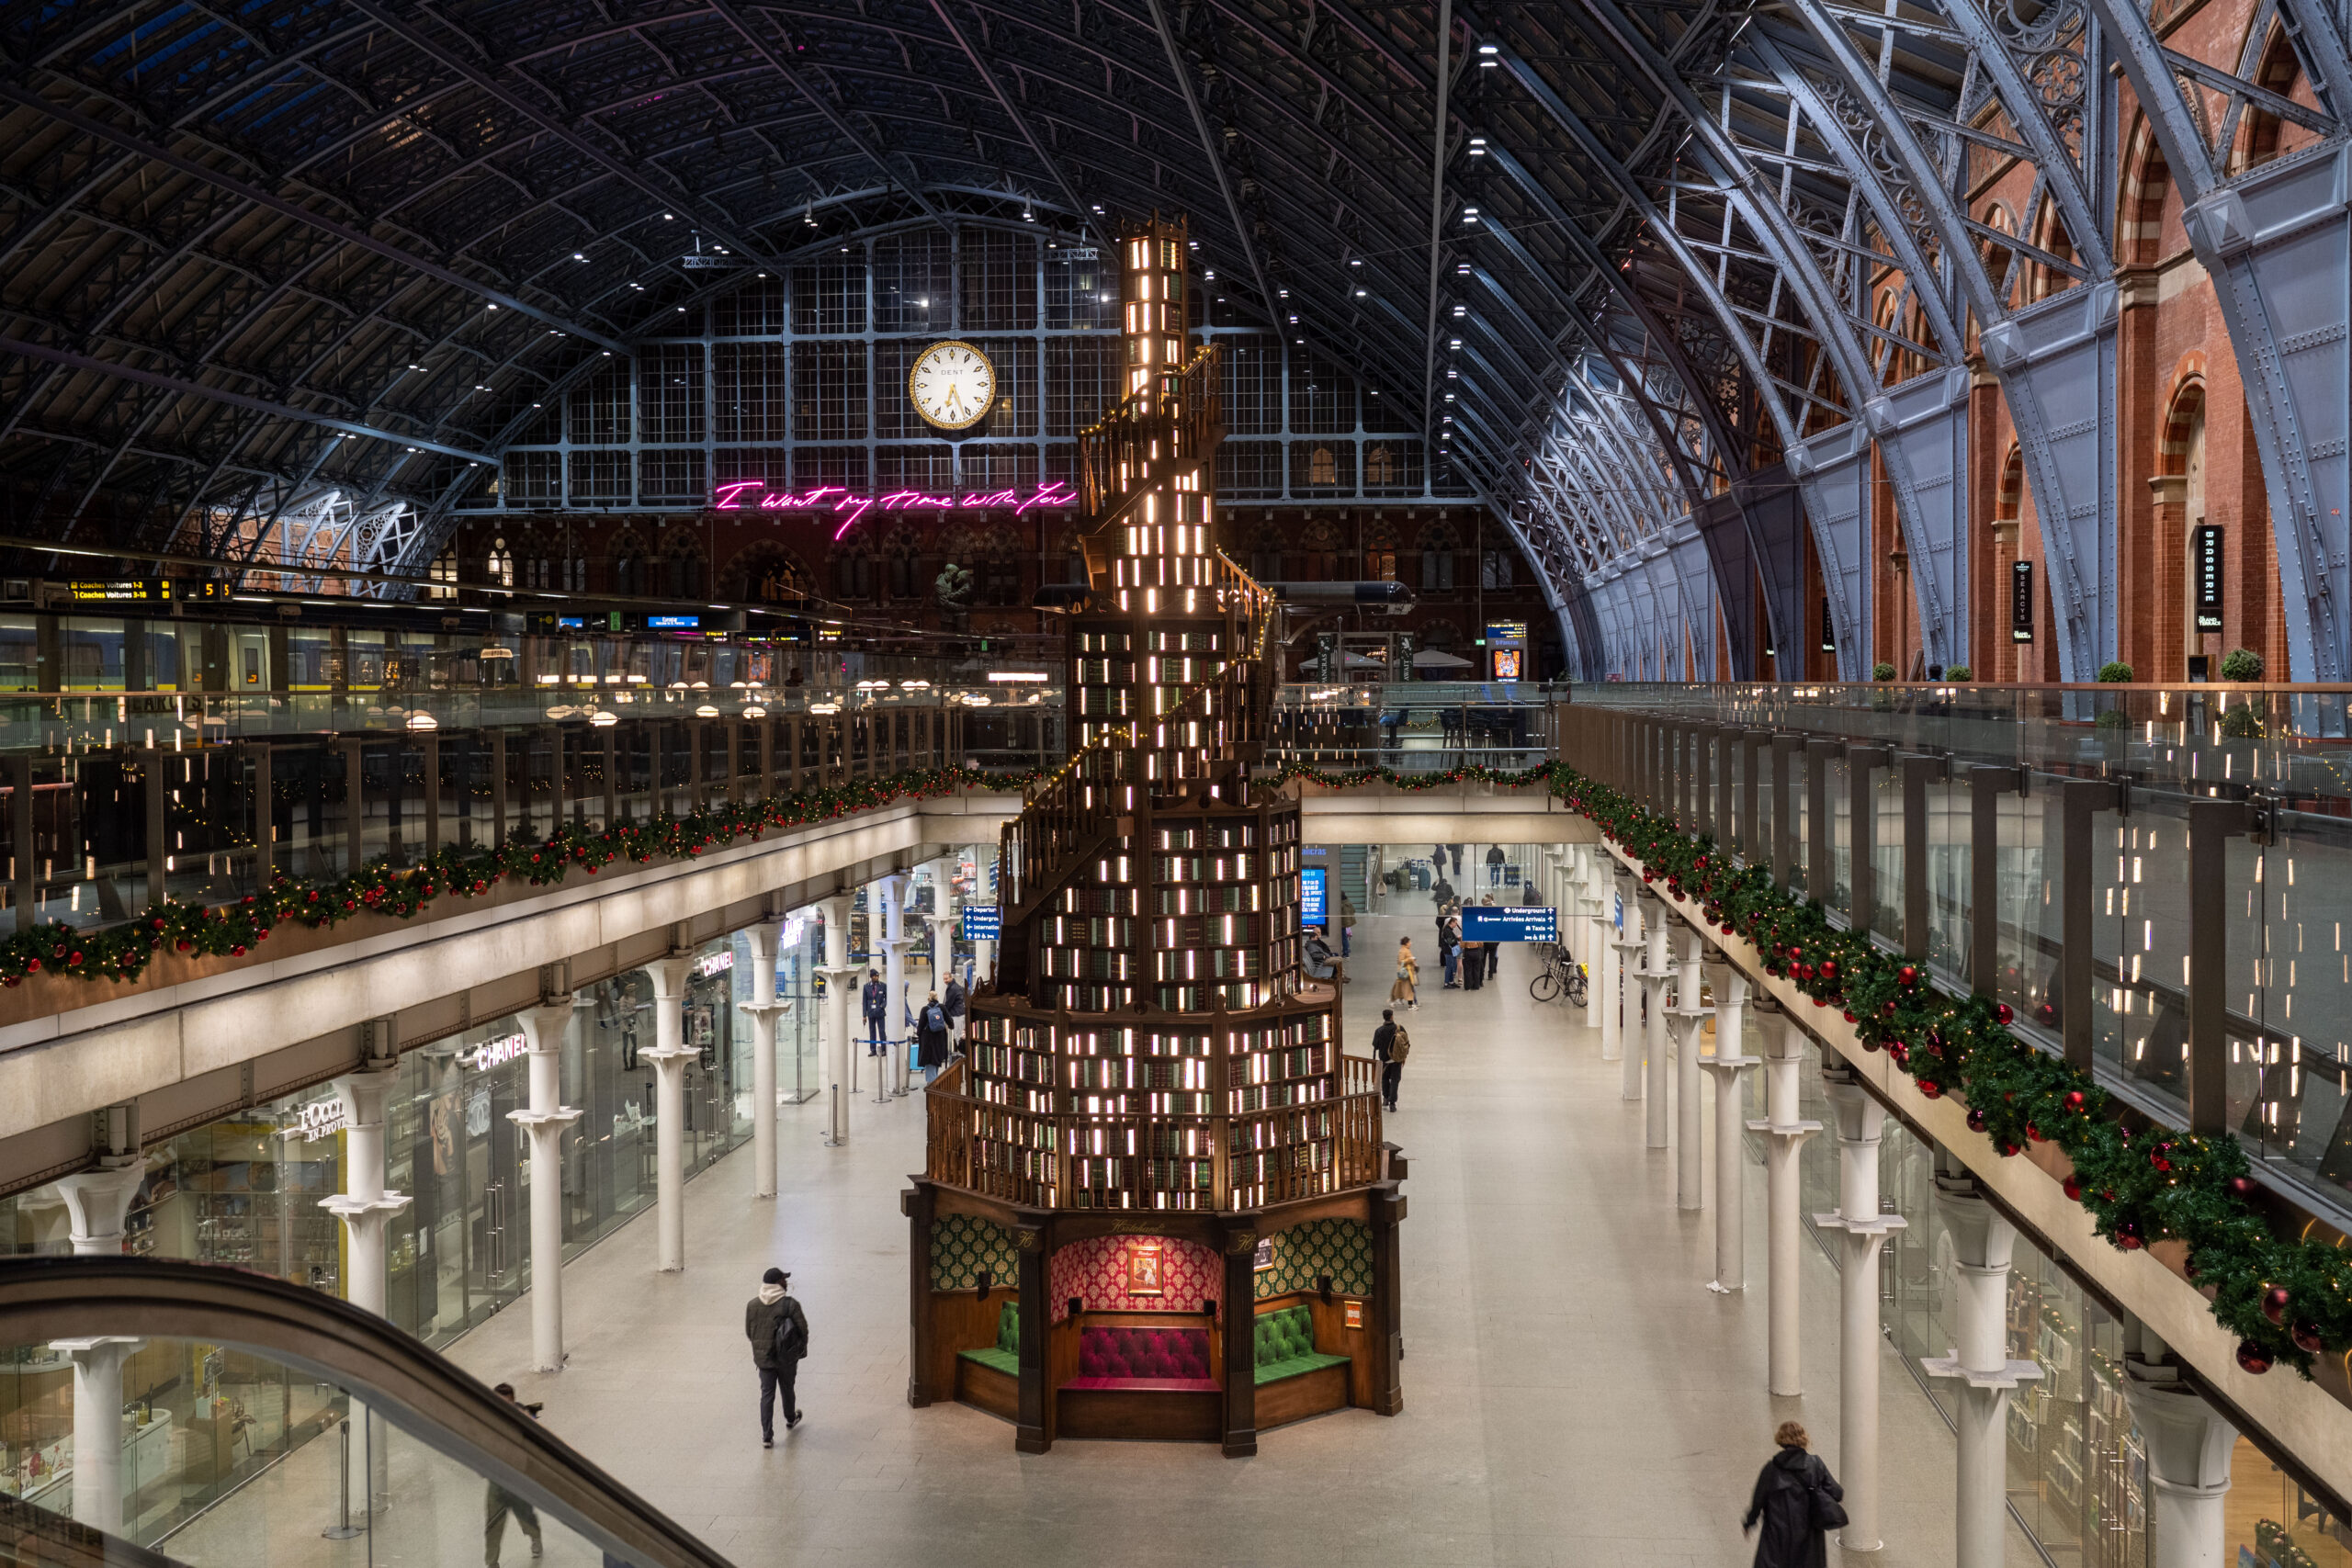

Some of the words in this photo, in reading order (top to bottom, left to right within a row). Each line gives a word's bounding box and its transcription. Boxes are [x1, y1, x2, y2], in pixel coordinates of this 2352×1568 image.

[717, 482, 763, 508] I
[834, 495, 874, 540] my
[2205, 531, 2214, 602] BRASSERIE
[206, 583, 213, 595] 5
[224, 584, 230, 596] 5
[704, 952, 733, 977] CHANEL
[478, 1032, 528, 1072] CHANEL
[307, 1128, 320, 1143] EN
